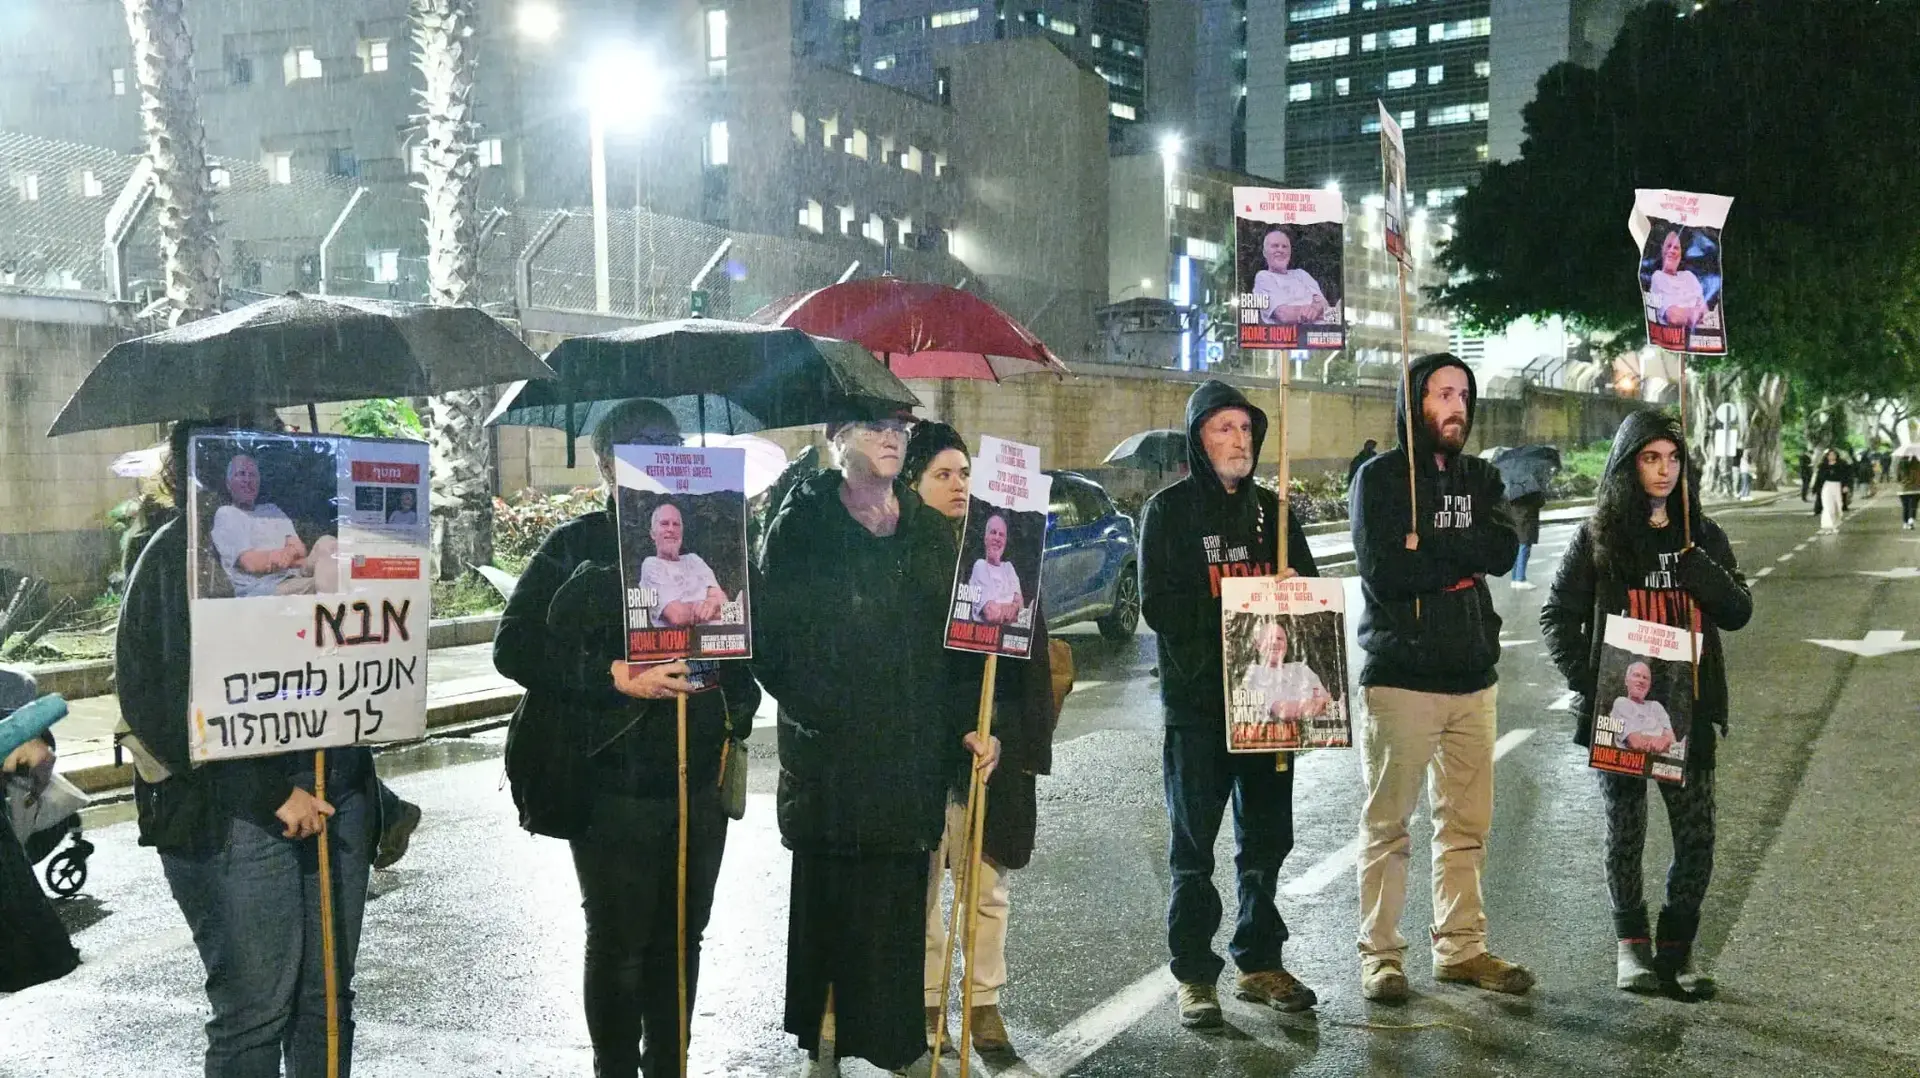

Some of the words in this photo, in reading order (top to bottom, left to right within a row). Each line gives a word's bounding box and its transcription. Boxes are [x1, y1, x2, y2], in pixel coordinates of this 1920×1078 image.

[1241, 293, 1269, 309] BRING
[1241, 309, 1259, 324] HIM
[1241, 326, 1268, 341] HOME
[1269, 325, 1297, 341] NOW!
[646, 465, 665, 477] KEITH
[1228, 546, 1249, 562] HOME
[627, 588, 658, 608] BRING
[957, 583, 982, 603] BRING
[629, 609, 648, 629] HIM
[953, 601, 971, 620] HIM
[315, 599, 410, 647] אבא
[951, 620, 975, 640] HOME
[630, 630, 657, 651] HOME
[659, 629, 690, 650] NOW!
[223, 661, 327, 705] מחכים
[338, 655, 417, 701] אנחנו
[1232, 689, 1265, 706] BRING
[344, 698, 384, 742] לך
[1597, 715, 1625, 733] BRING
[1595, 730, 1614, 746] HIM
[1593, 746, 1617, 763] HOME
[1619, 750, 1645, 769] NOW!
